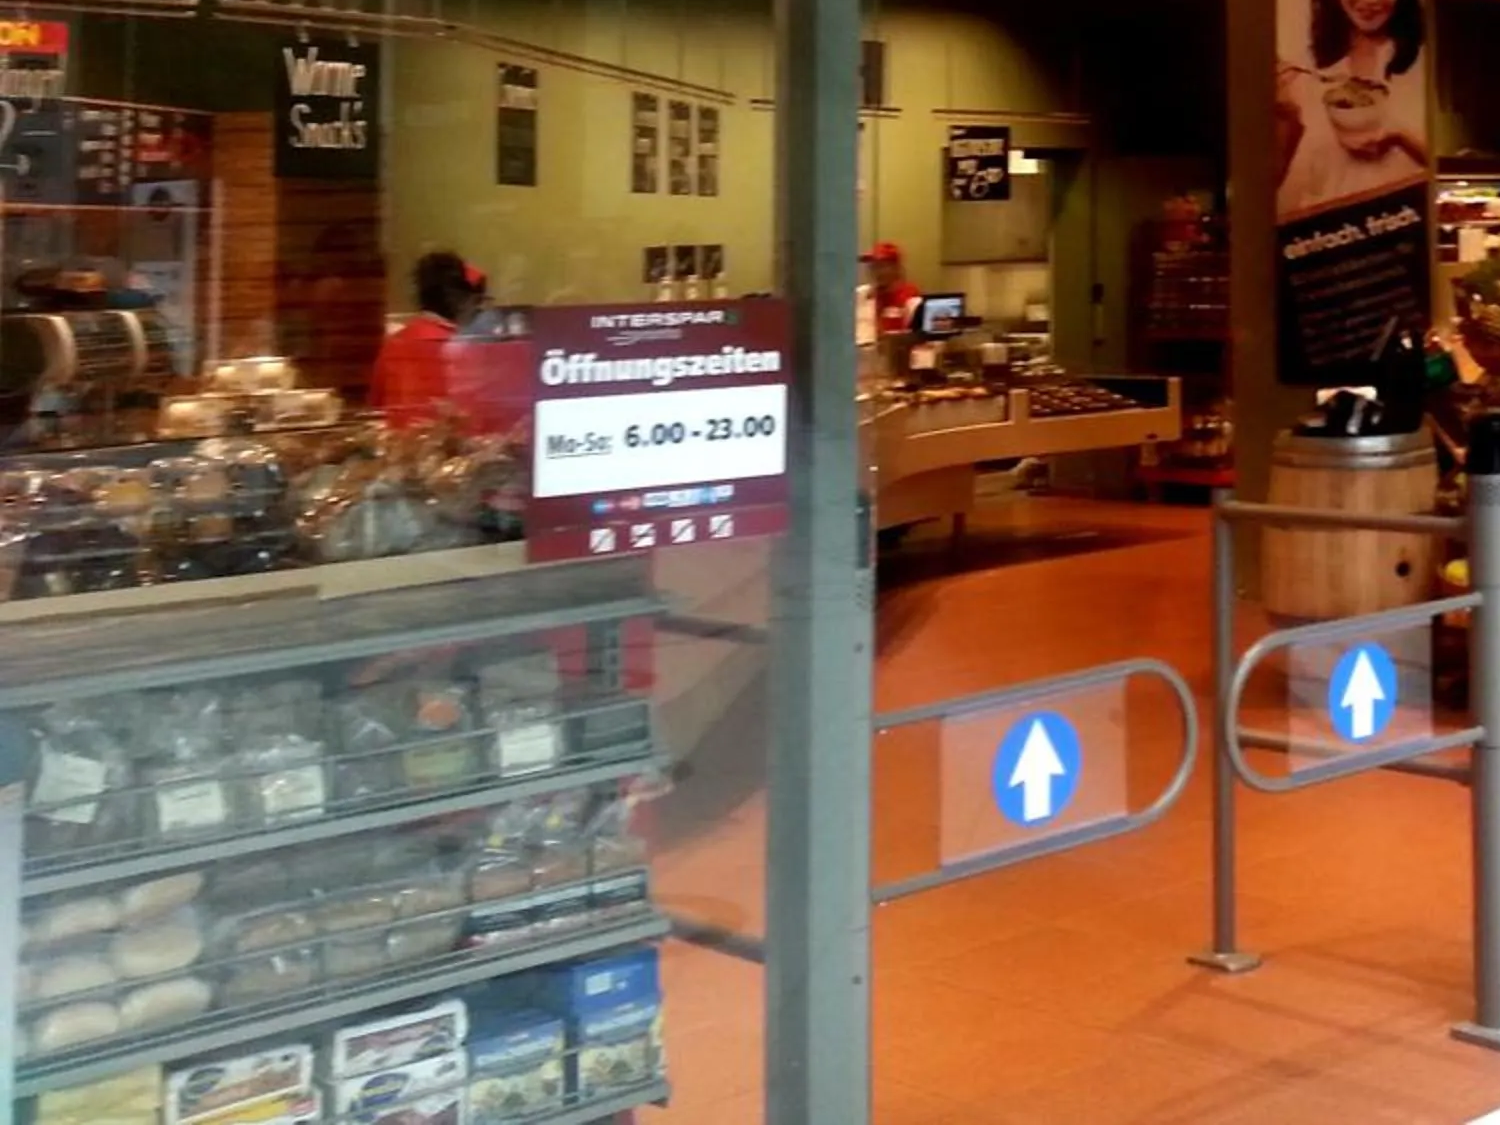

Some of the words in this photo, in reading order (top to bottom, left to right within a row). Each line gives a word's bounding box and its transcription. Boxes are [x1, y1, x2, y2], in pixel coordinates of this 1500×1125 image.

[591, 310, 724, 329] INTERSPAR
[540, 346, 781, 386] Öffnungszeiten
[624, 422, 686, 449] 6.00
[705, 414, 776, 442] 23.00
